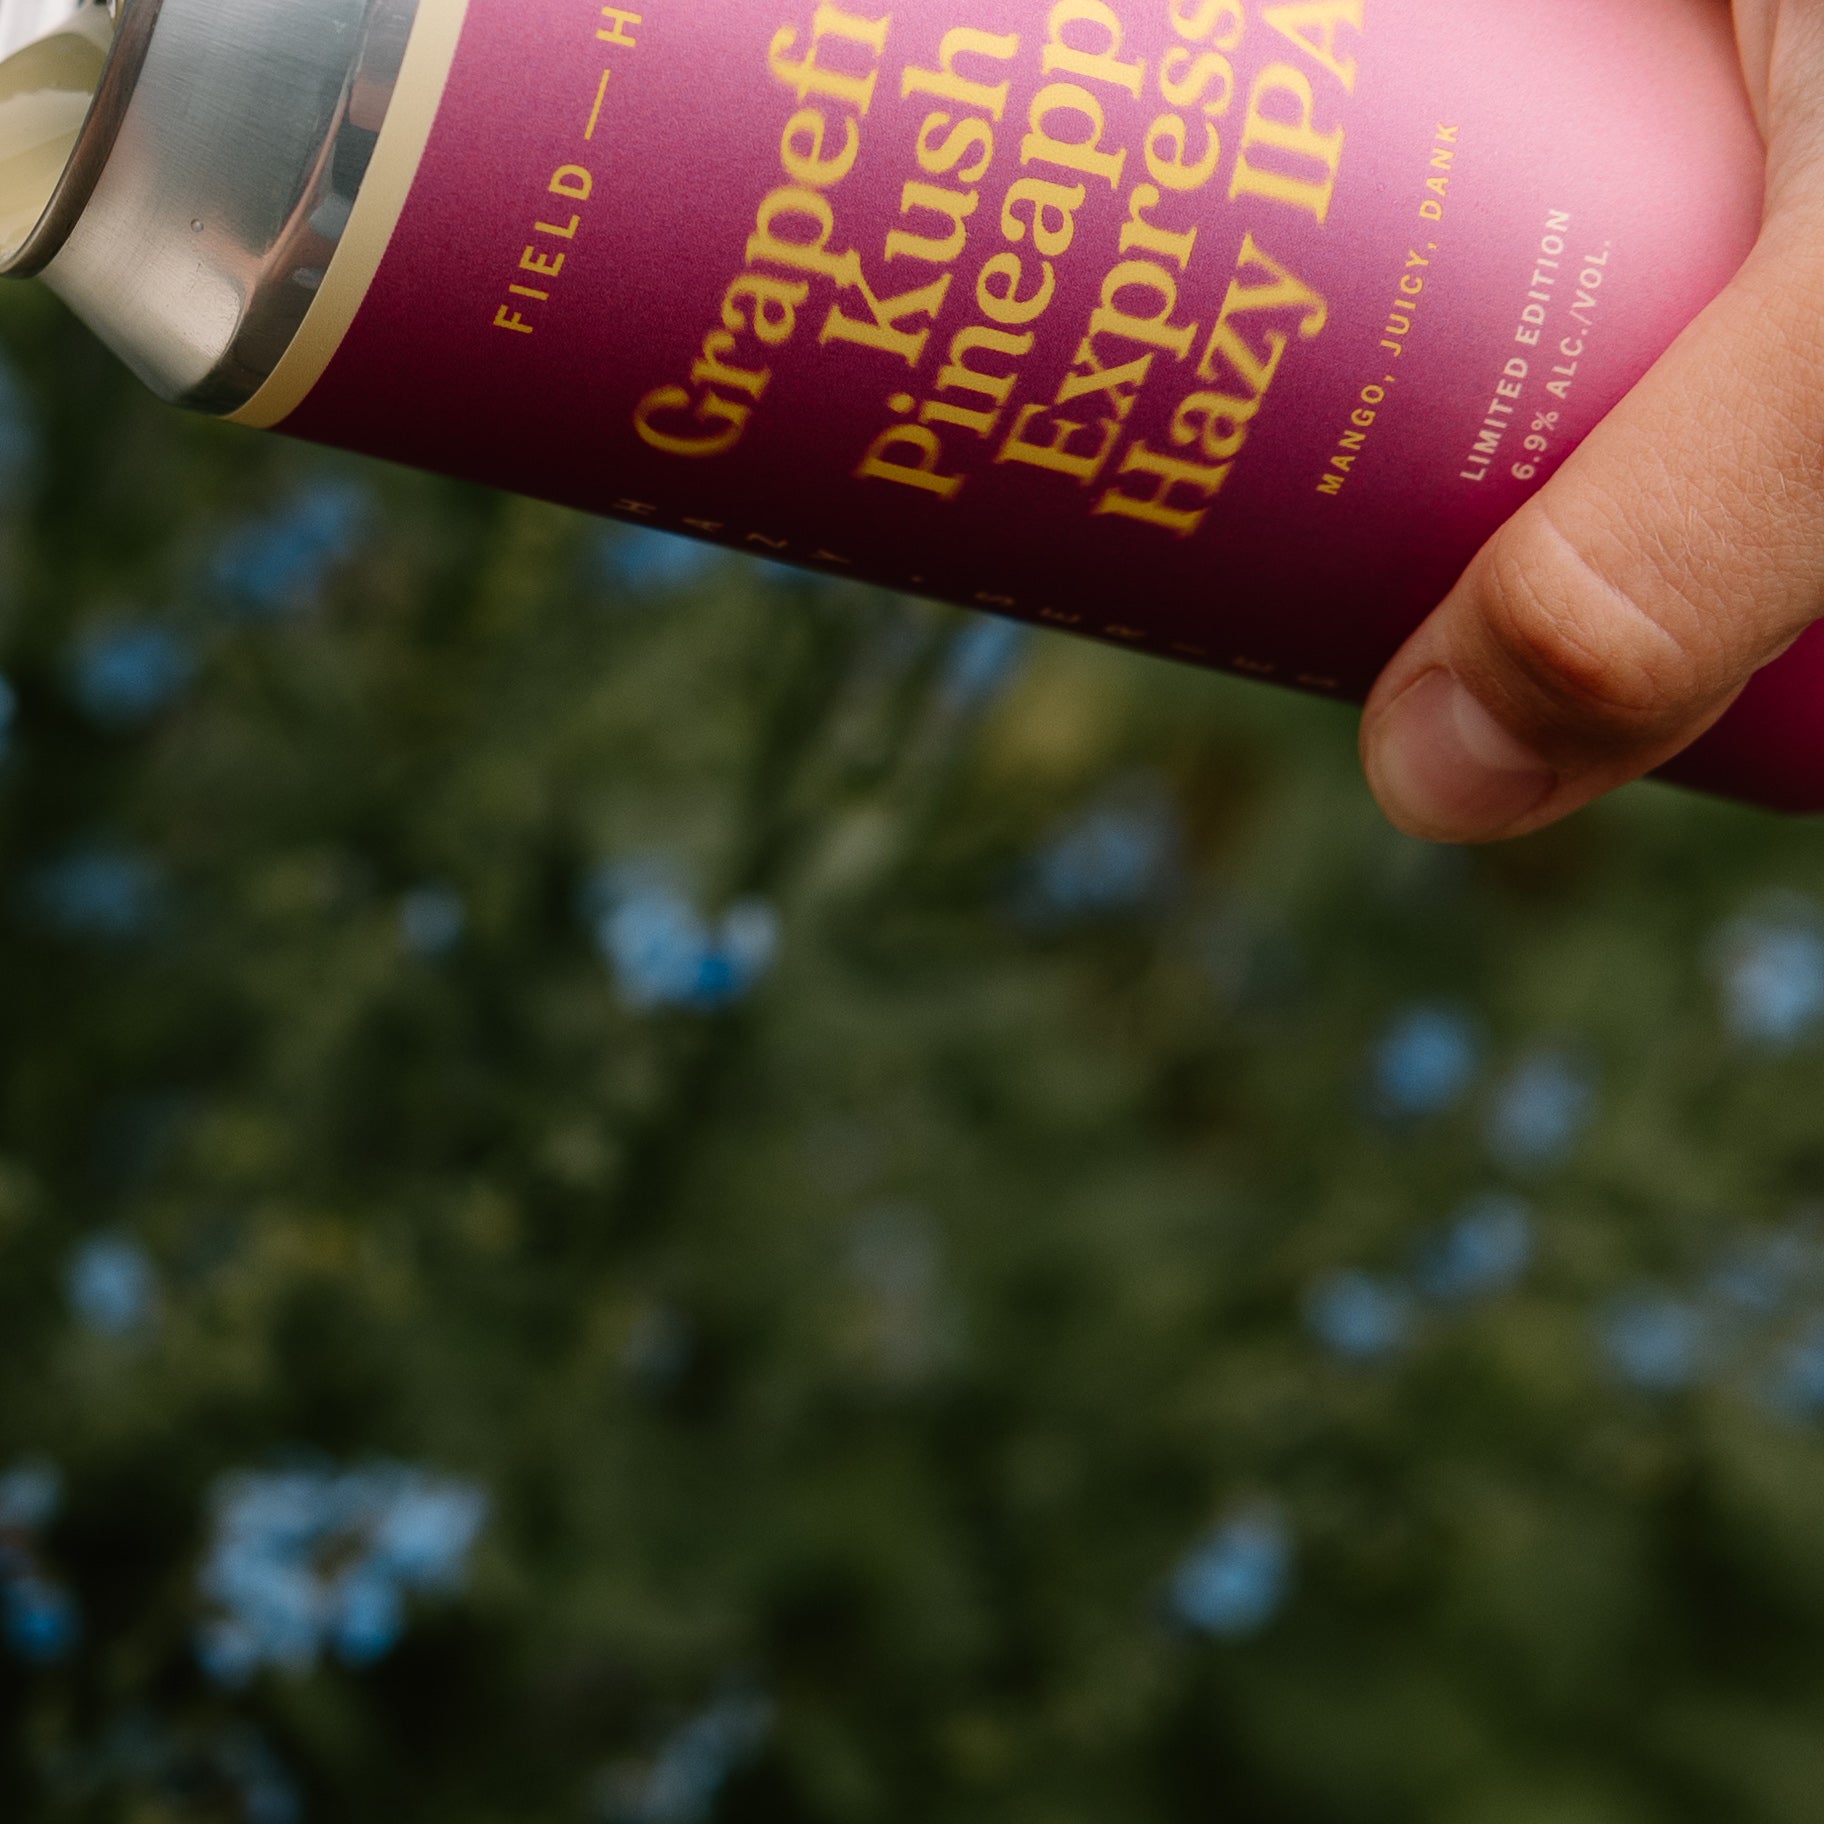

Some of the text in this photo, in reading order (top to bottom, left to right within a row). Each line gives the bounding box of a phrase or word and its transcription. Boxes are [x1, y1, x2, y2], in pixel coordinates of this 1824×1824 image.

[493, 163, 593, 334] FIELD
[819, 26, 1020, 367] Kush
[1316, 121, 1459, 495] MANGO, JUICY, DANK
[1093, 232, 1327, 537] Hazy
[1460, 209, 1570, 481] LIMITED EDITION
[1511, 240, 1611, 480] 6.9% ALC./VOL.
